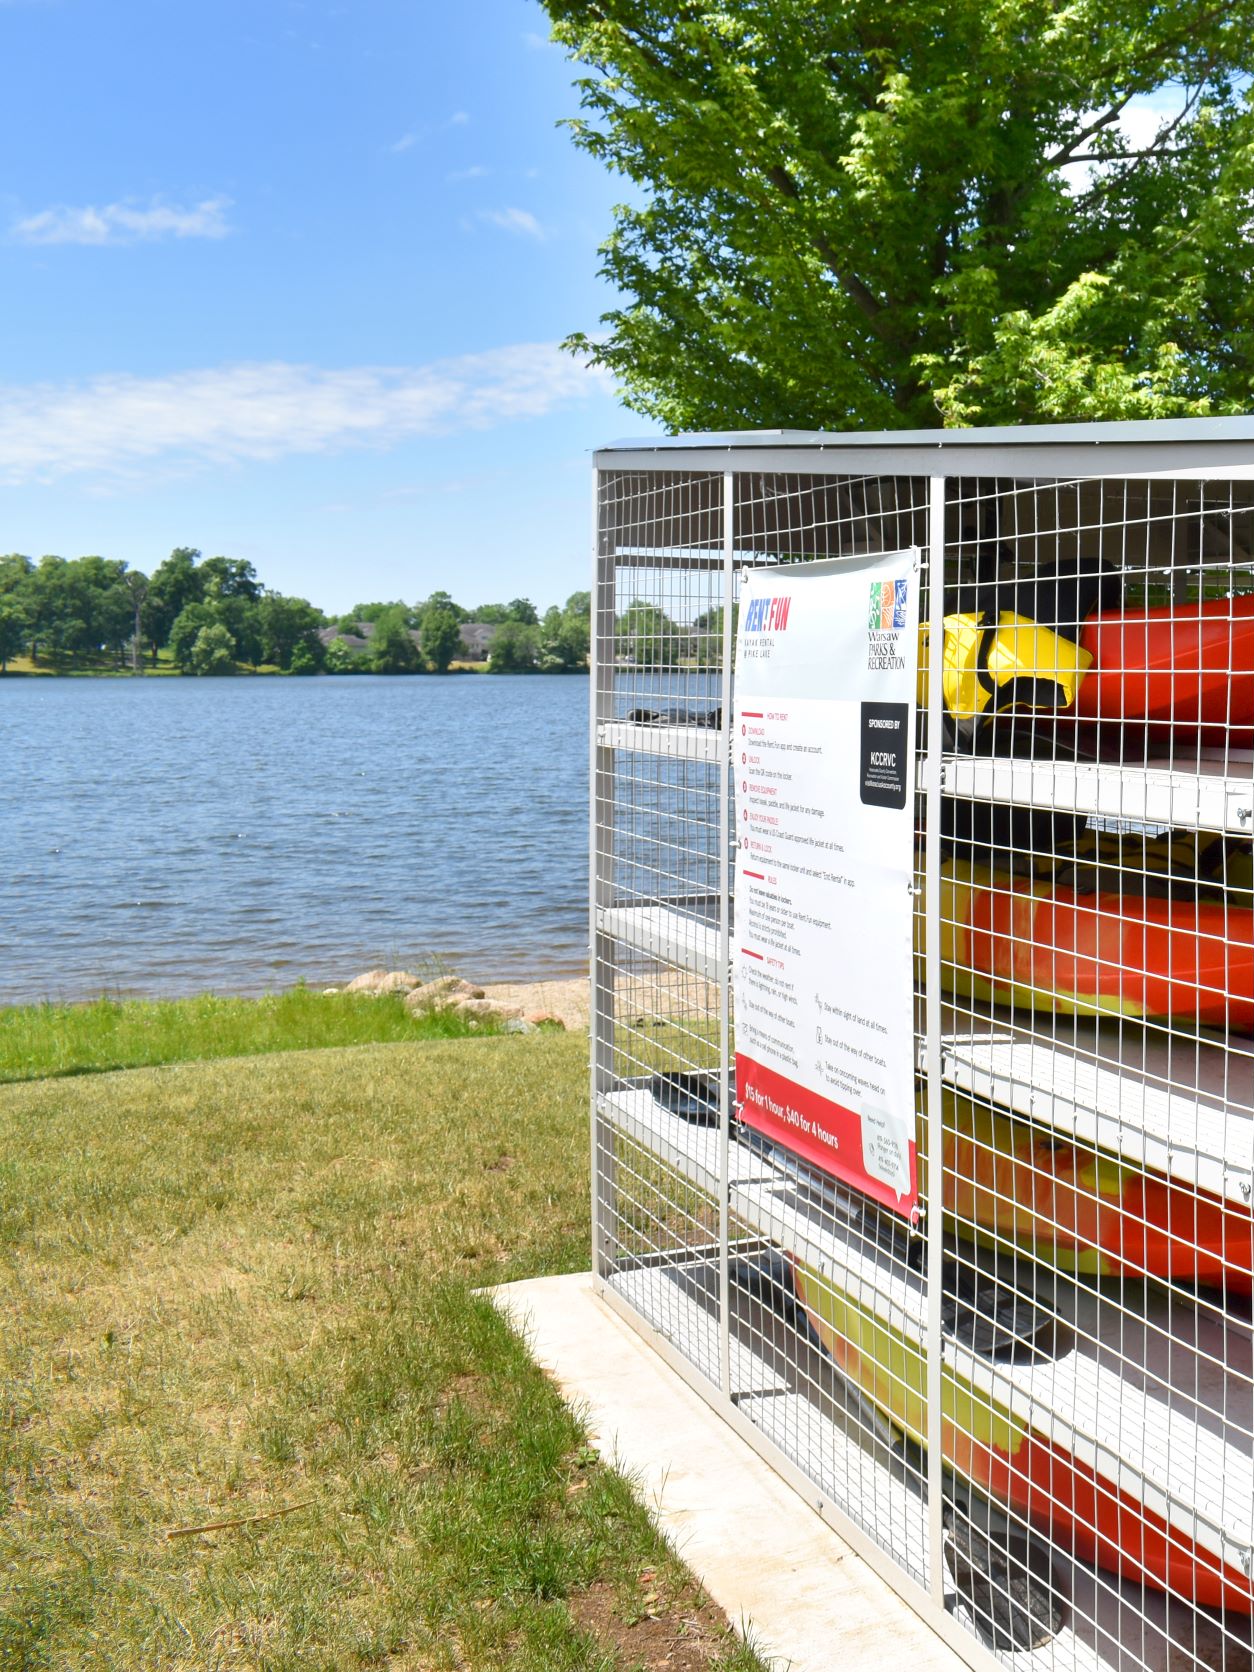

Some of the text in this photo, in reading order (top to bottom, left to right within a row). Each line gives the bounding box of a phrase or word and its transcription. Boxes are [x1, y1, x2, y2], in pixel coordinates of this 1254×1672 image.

[868, 632, 899, 641] Warsaw
[868, 643, 895, 656] PARKS &
[867, 656, 905, 670] RECREATION
[868, 719, 900, 729] SPONSORED BY
[870, 752, 897, 767] KCCRVC
[745, 1083, 838, 1149] $15 for 1 hour, $40 for 4 hours
